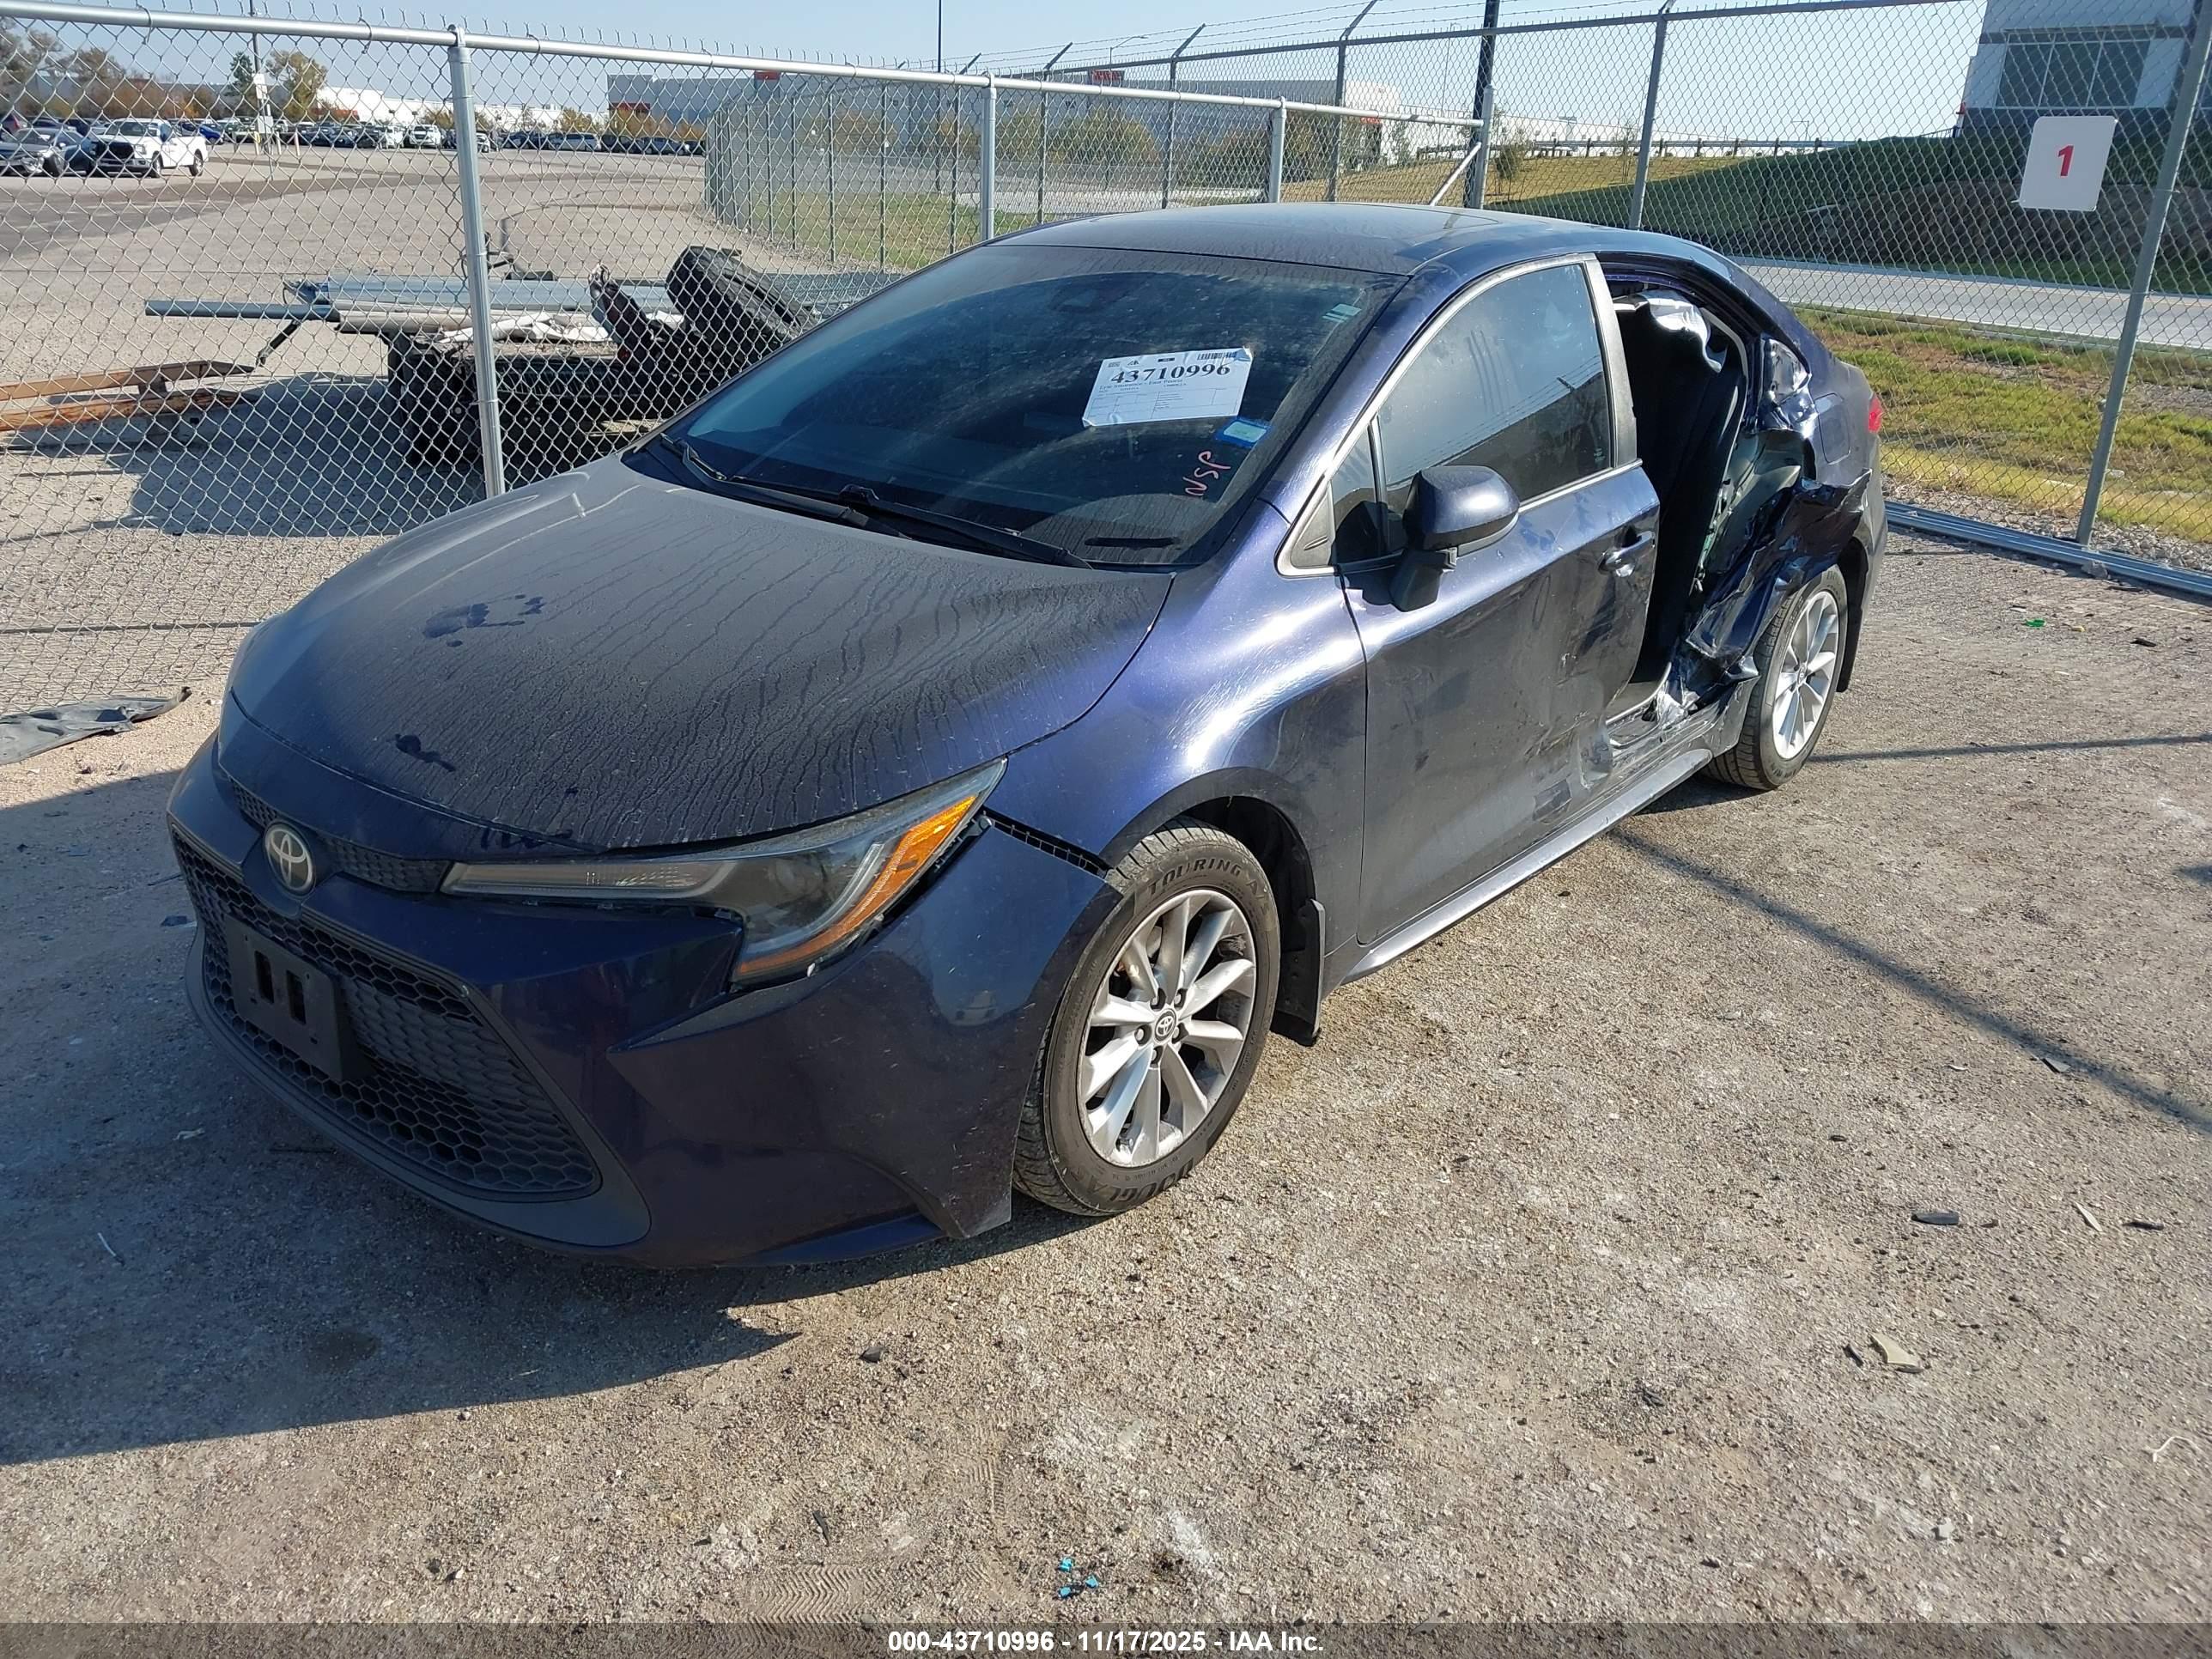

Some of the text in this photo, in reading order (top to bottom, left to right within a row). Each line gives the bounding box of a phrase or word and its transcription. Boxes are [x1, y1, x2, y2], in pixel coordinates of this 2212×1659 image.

[2057, 145, 2074, 177] 1
[1110, 363, 1231, 384] 43710996
[1147, 858, 1242, 896] TOURING
